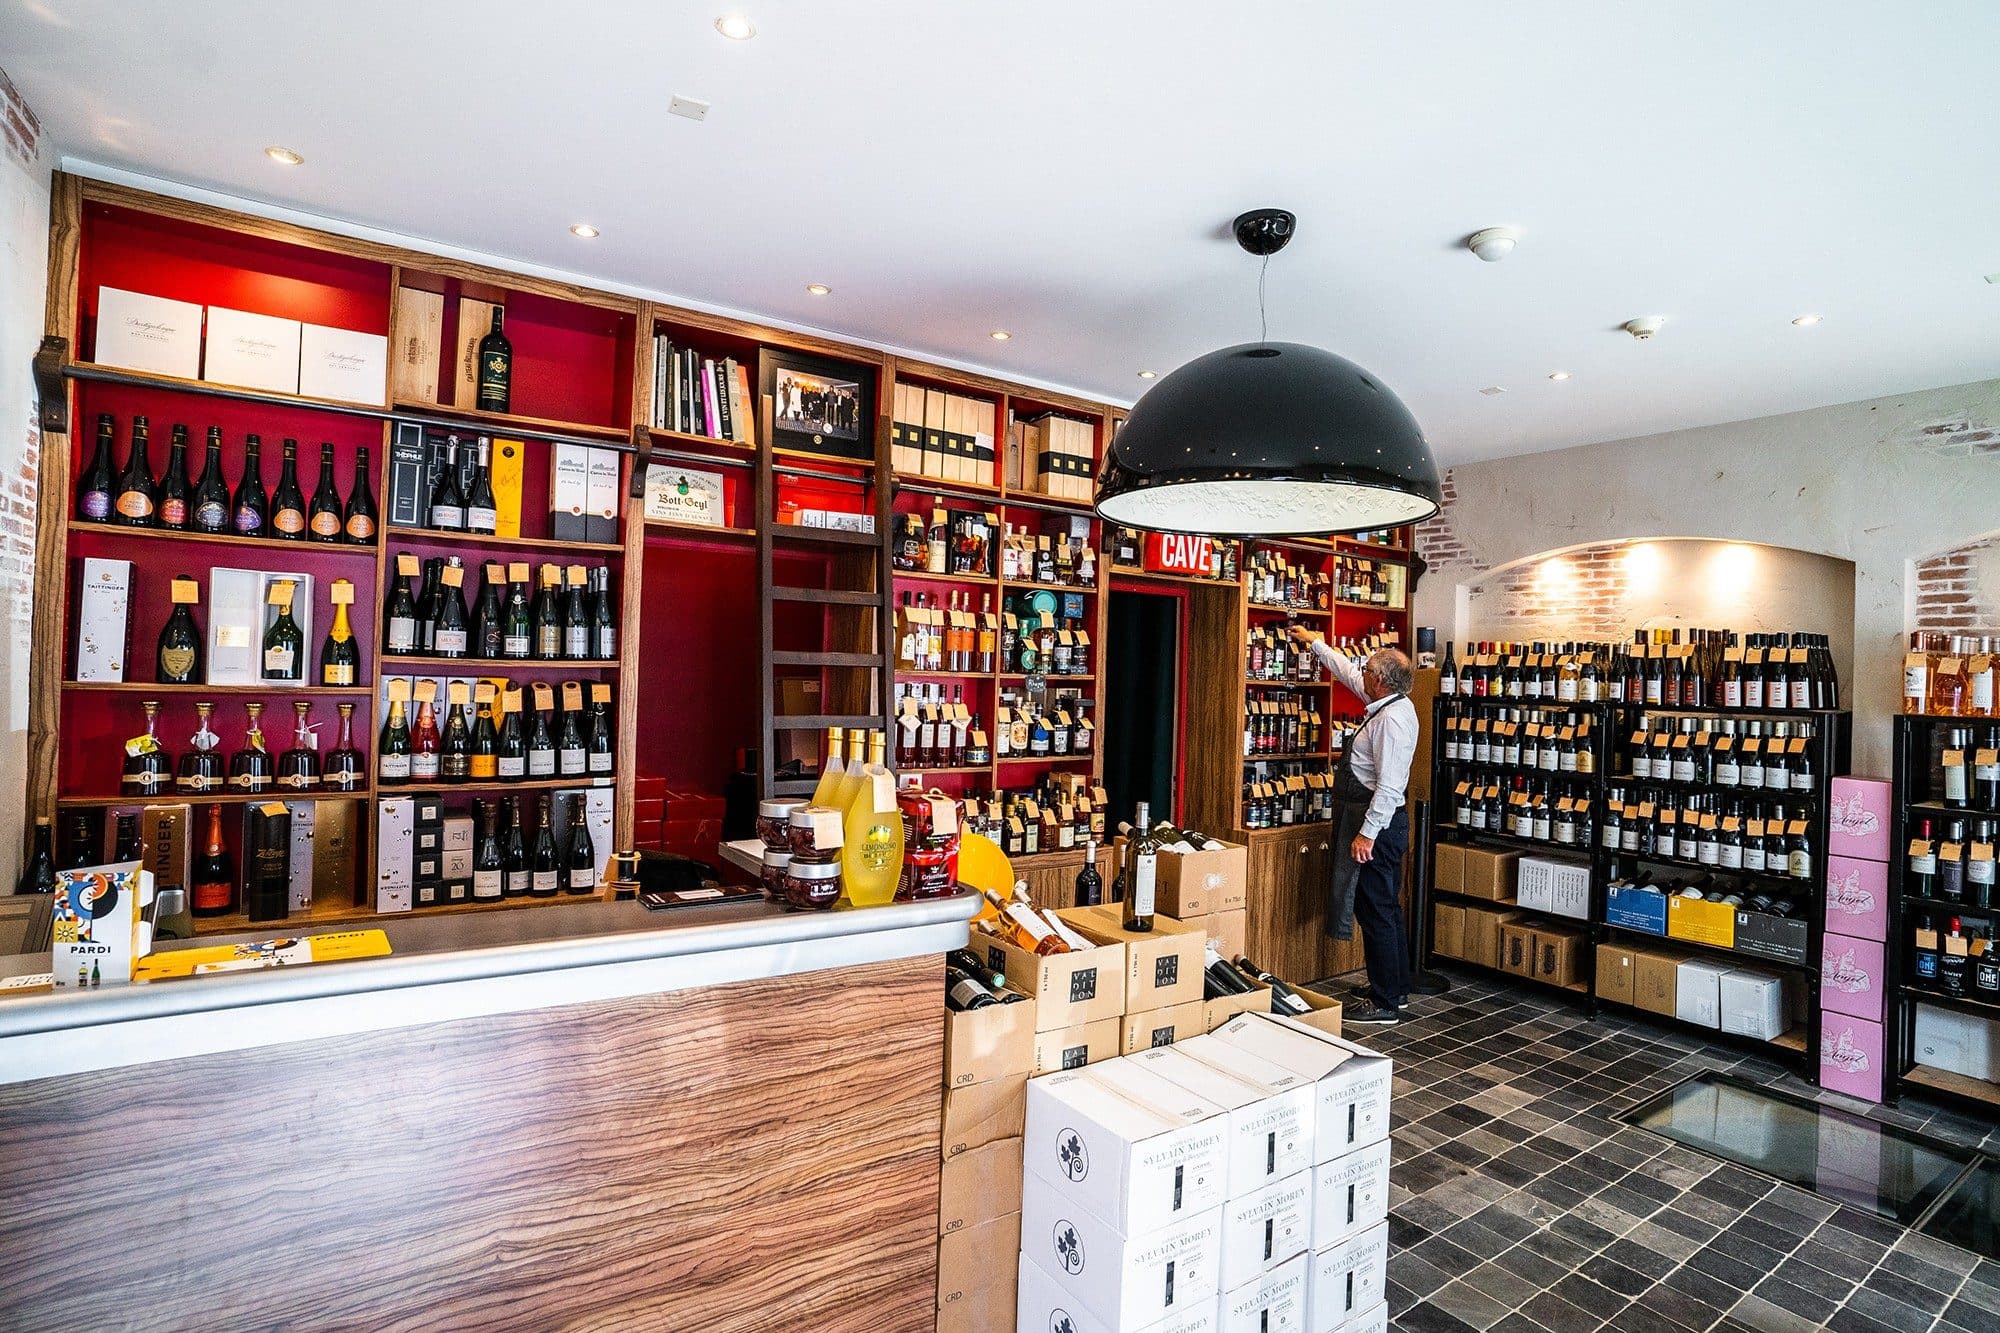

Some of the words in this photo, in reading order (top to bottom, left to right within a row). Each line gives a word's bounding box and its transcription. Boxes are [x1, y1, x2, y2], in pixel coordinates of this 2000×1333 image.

[1161, 533, 1211, 571] CAVE
[70, 945, 111, 955] PARDI
[1157, 955, 1178, 967] VAL
[1919, 961, 1936, 971] ONE
[1073, 970, 1096, 980] VAL
[1157, 965, 1177, 976] DIT
[1156, 975, 1176, 986] ION
[1979, 972, 1998, 984] ONE
[1073, 980, 1095, 990] DIT
[1071, 990, 1095, 1000] ION
[1153, 1027, 1173, 1039] VAL
[1065, 1047, 1086, 1058] VAL
[956, 1072, 974, 1084] CRD
[950, 1143, 967, 1155] CRD
[946, 1219, 963, 1231] CRD
[945, 1291, 963, 1303] CRD
